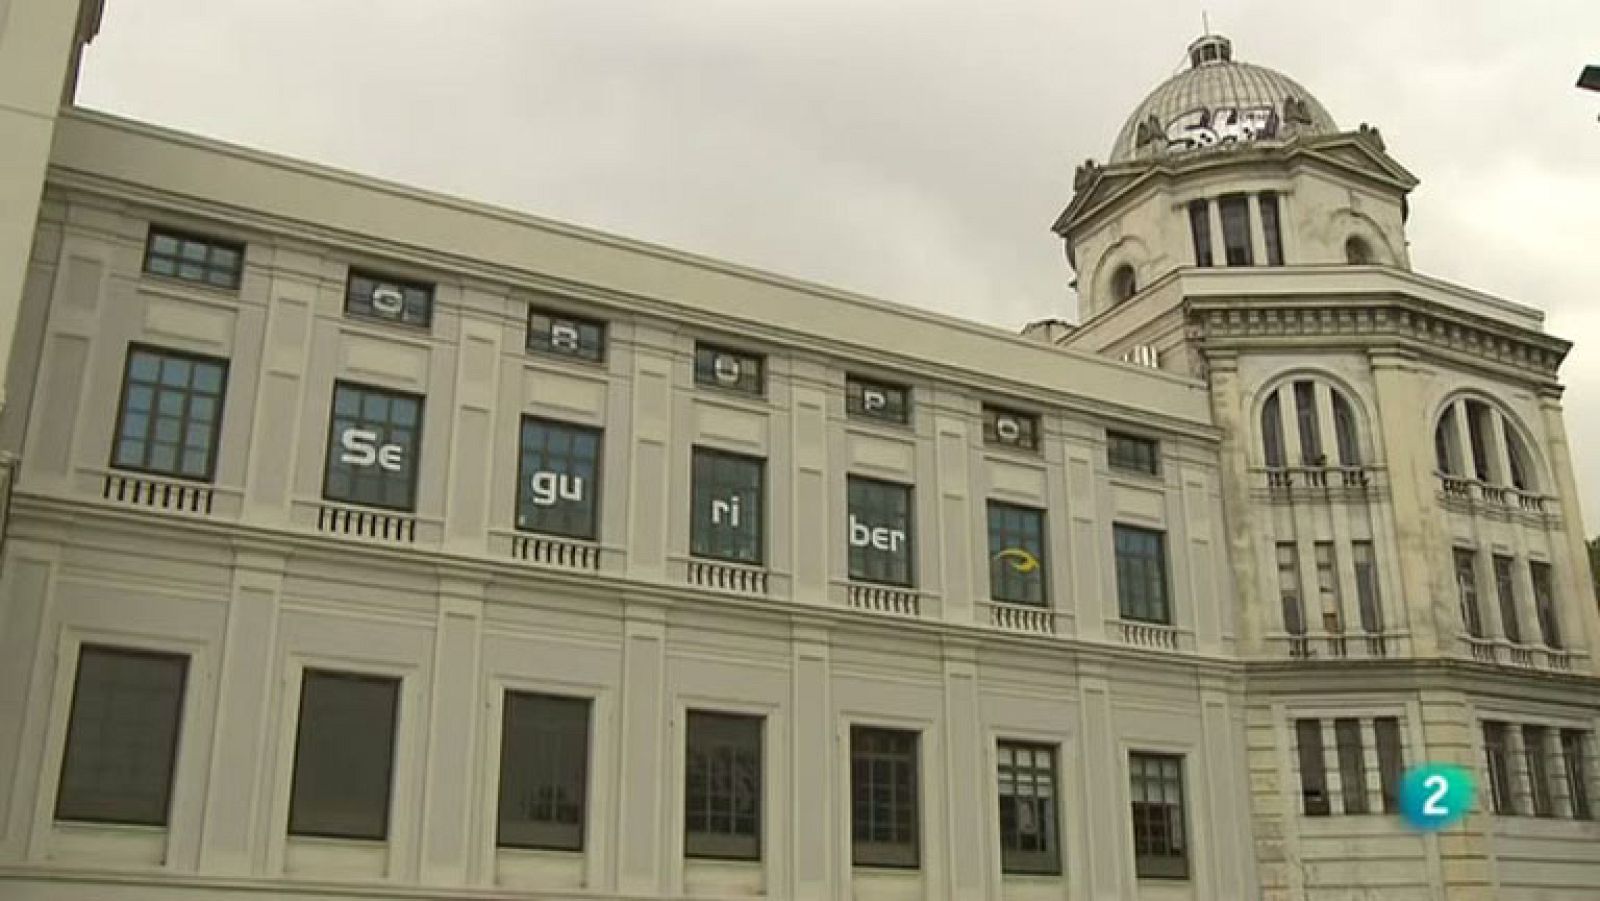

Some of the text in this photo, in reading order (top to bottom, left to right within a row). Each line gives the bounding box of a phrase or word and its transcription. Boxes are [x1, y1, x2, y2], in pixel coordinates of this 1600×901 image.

[531, 471, 582, 505] gu
[711, 497, 740, 527] ri
[850, 515, 905, 551] ber
